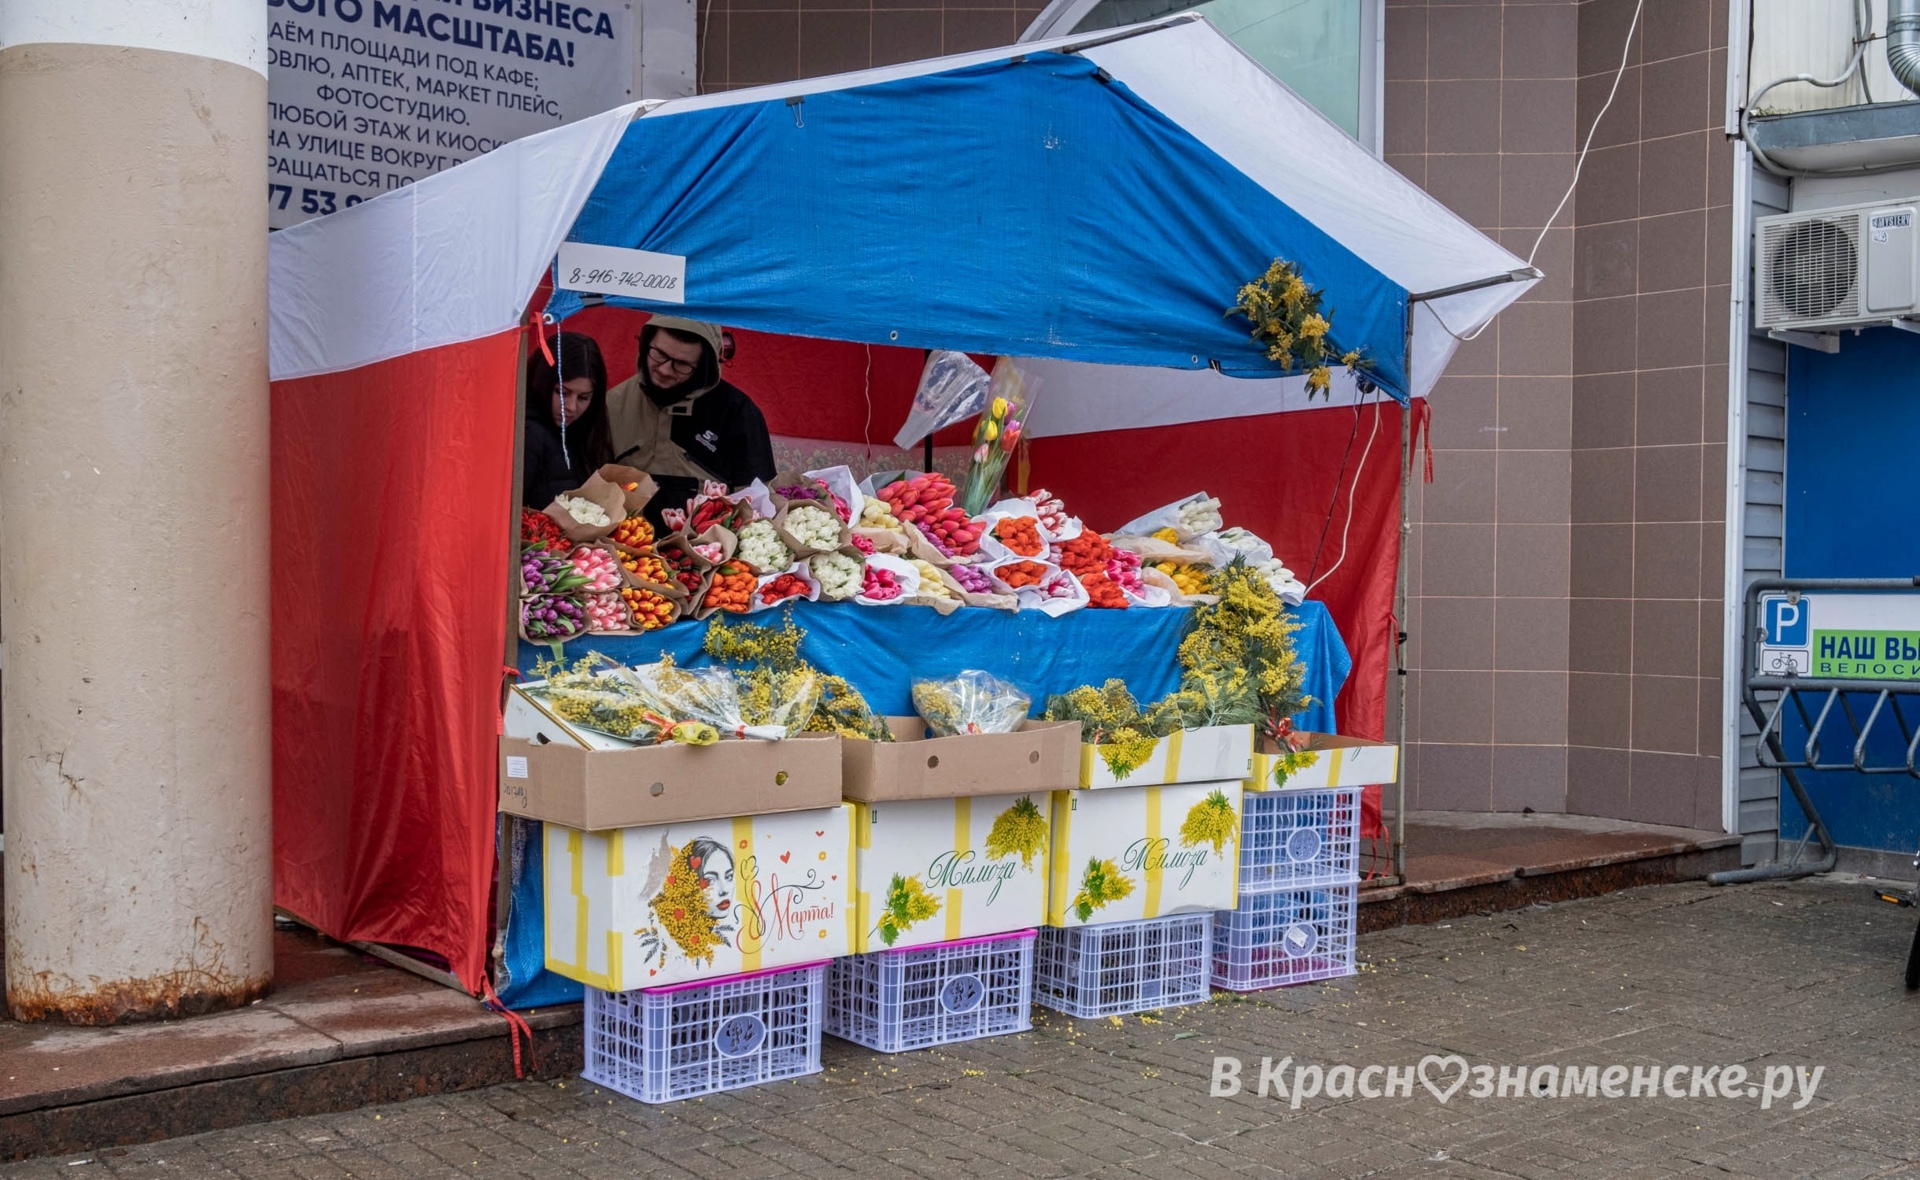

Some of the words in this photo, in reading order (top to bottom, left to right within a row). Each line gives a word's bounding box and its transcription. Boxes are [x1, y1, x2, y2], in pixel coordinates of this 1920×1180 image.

[373, 0, 575, 68] МАСШТАБА!
[268, 20, 314, 46] АЁМ
[321, 31, 430, 68] ПЛОЩАДИ
[436, 54, 478, 80] ПОД
[483, 63, 539, 92] КАФЕ;
[316, 84, 470, 127] ФОТОСТУДИЮ.
[341, 62, 411, 93] АПТЕК,
[416, 75, 492, 105] МАРКЕТ
[496, 91, 563, 121] ПЛЕЙС,
[353, 116, 411, 142] ЭТАЖ
[417, 127, 430, 145] И
[297, 133, 365, 162] УЛИЦЕ
[371, 145, 447, 172] ВОКРУГ
[301, 188, 338, 216] 53
[569, 268, 678, 289] 8-916-742-0008
[1776, 603, 1800, 642] P
[1820, 636, 1876, 660] НАШ
[926, 850, 1017, 906] Мимоза
[1121, 837, 1209, 891] Мимоза
[765, 873, 834, 941] Марта!
